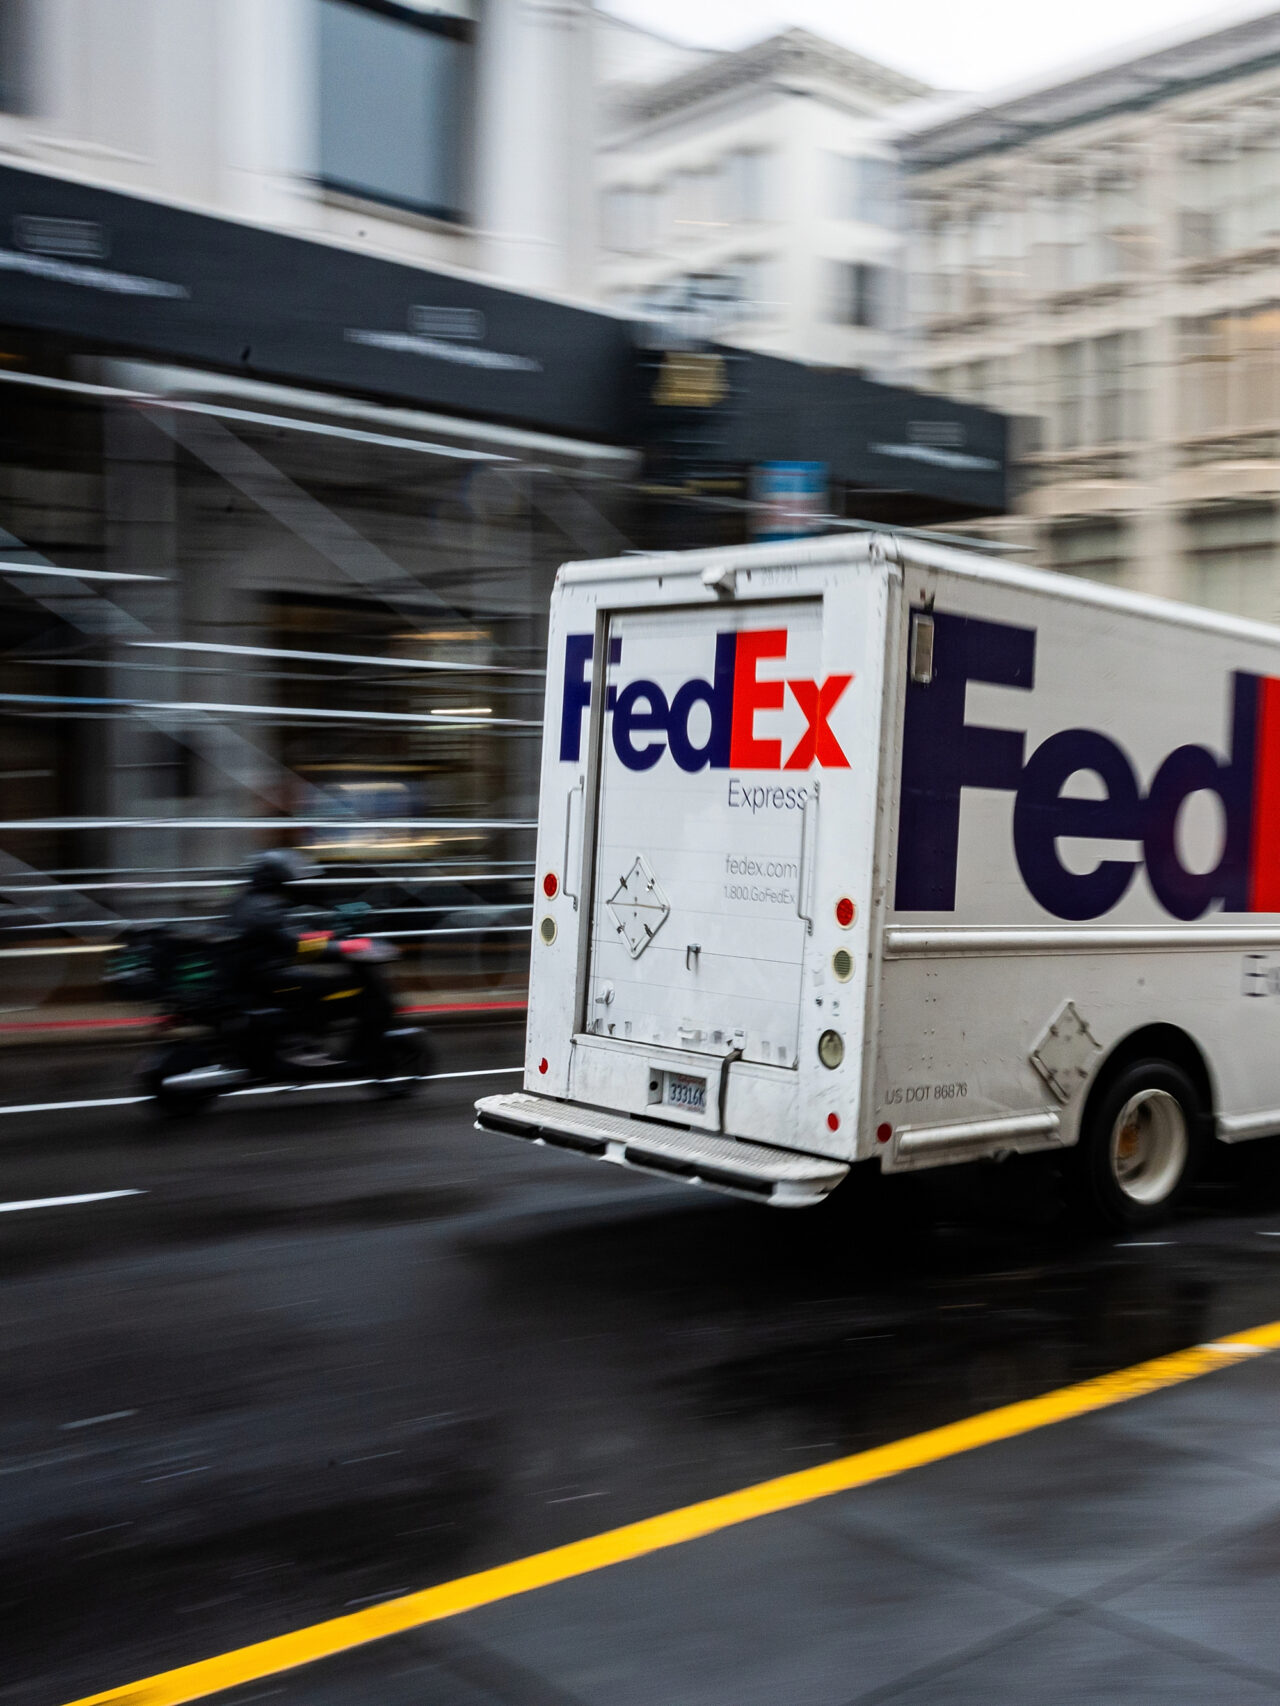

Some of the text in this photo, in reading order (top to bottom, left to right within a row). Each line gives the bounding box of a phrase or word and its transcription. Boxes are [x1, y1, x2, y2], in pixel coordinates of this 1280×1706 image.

[560, 627, 855, 773] FedEx
[728, 777, 808, 815] Express
[726, 853, 799, 879] fedex.com
[885, 1087, 903, 1105] US
[905, 1086, 931, 1104] DOT
